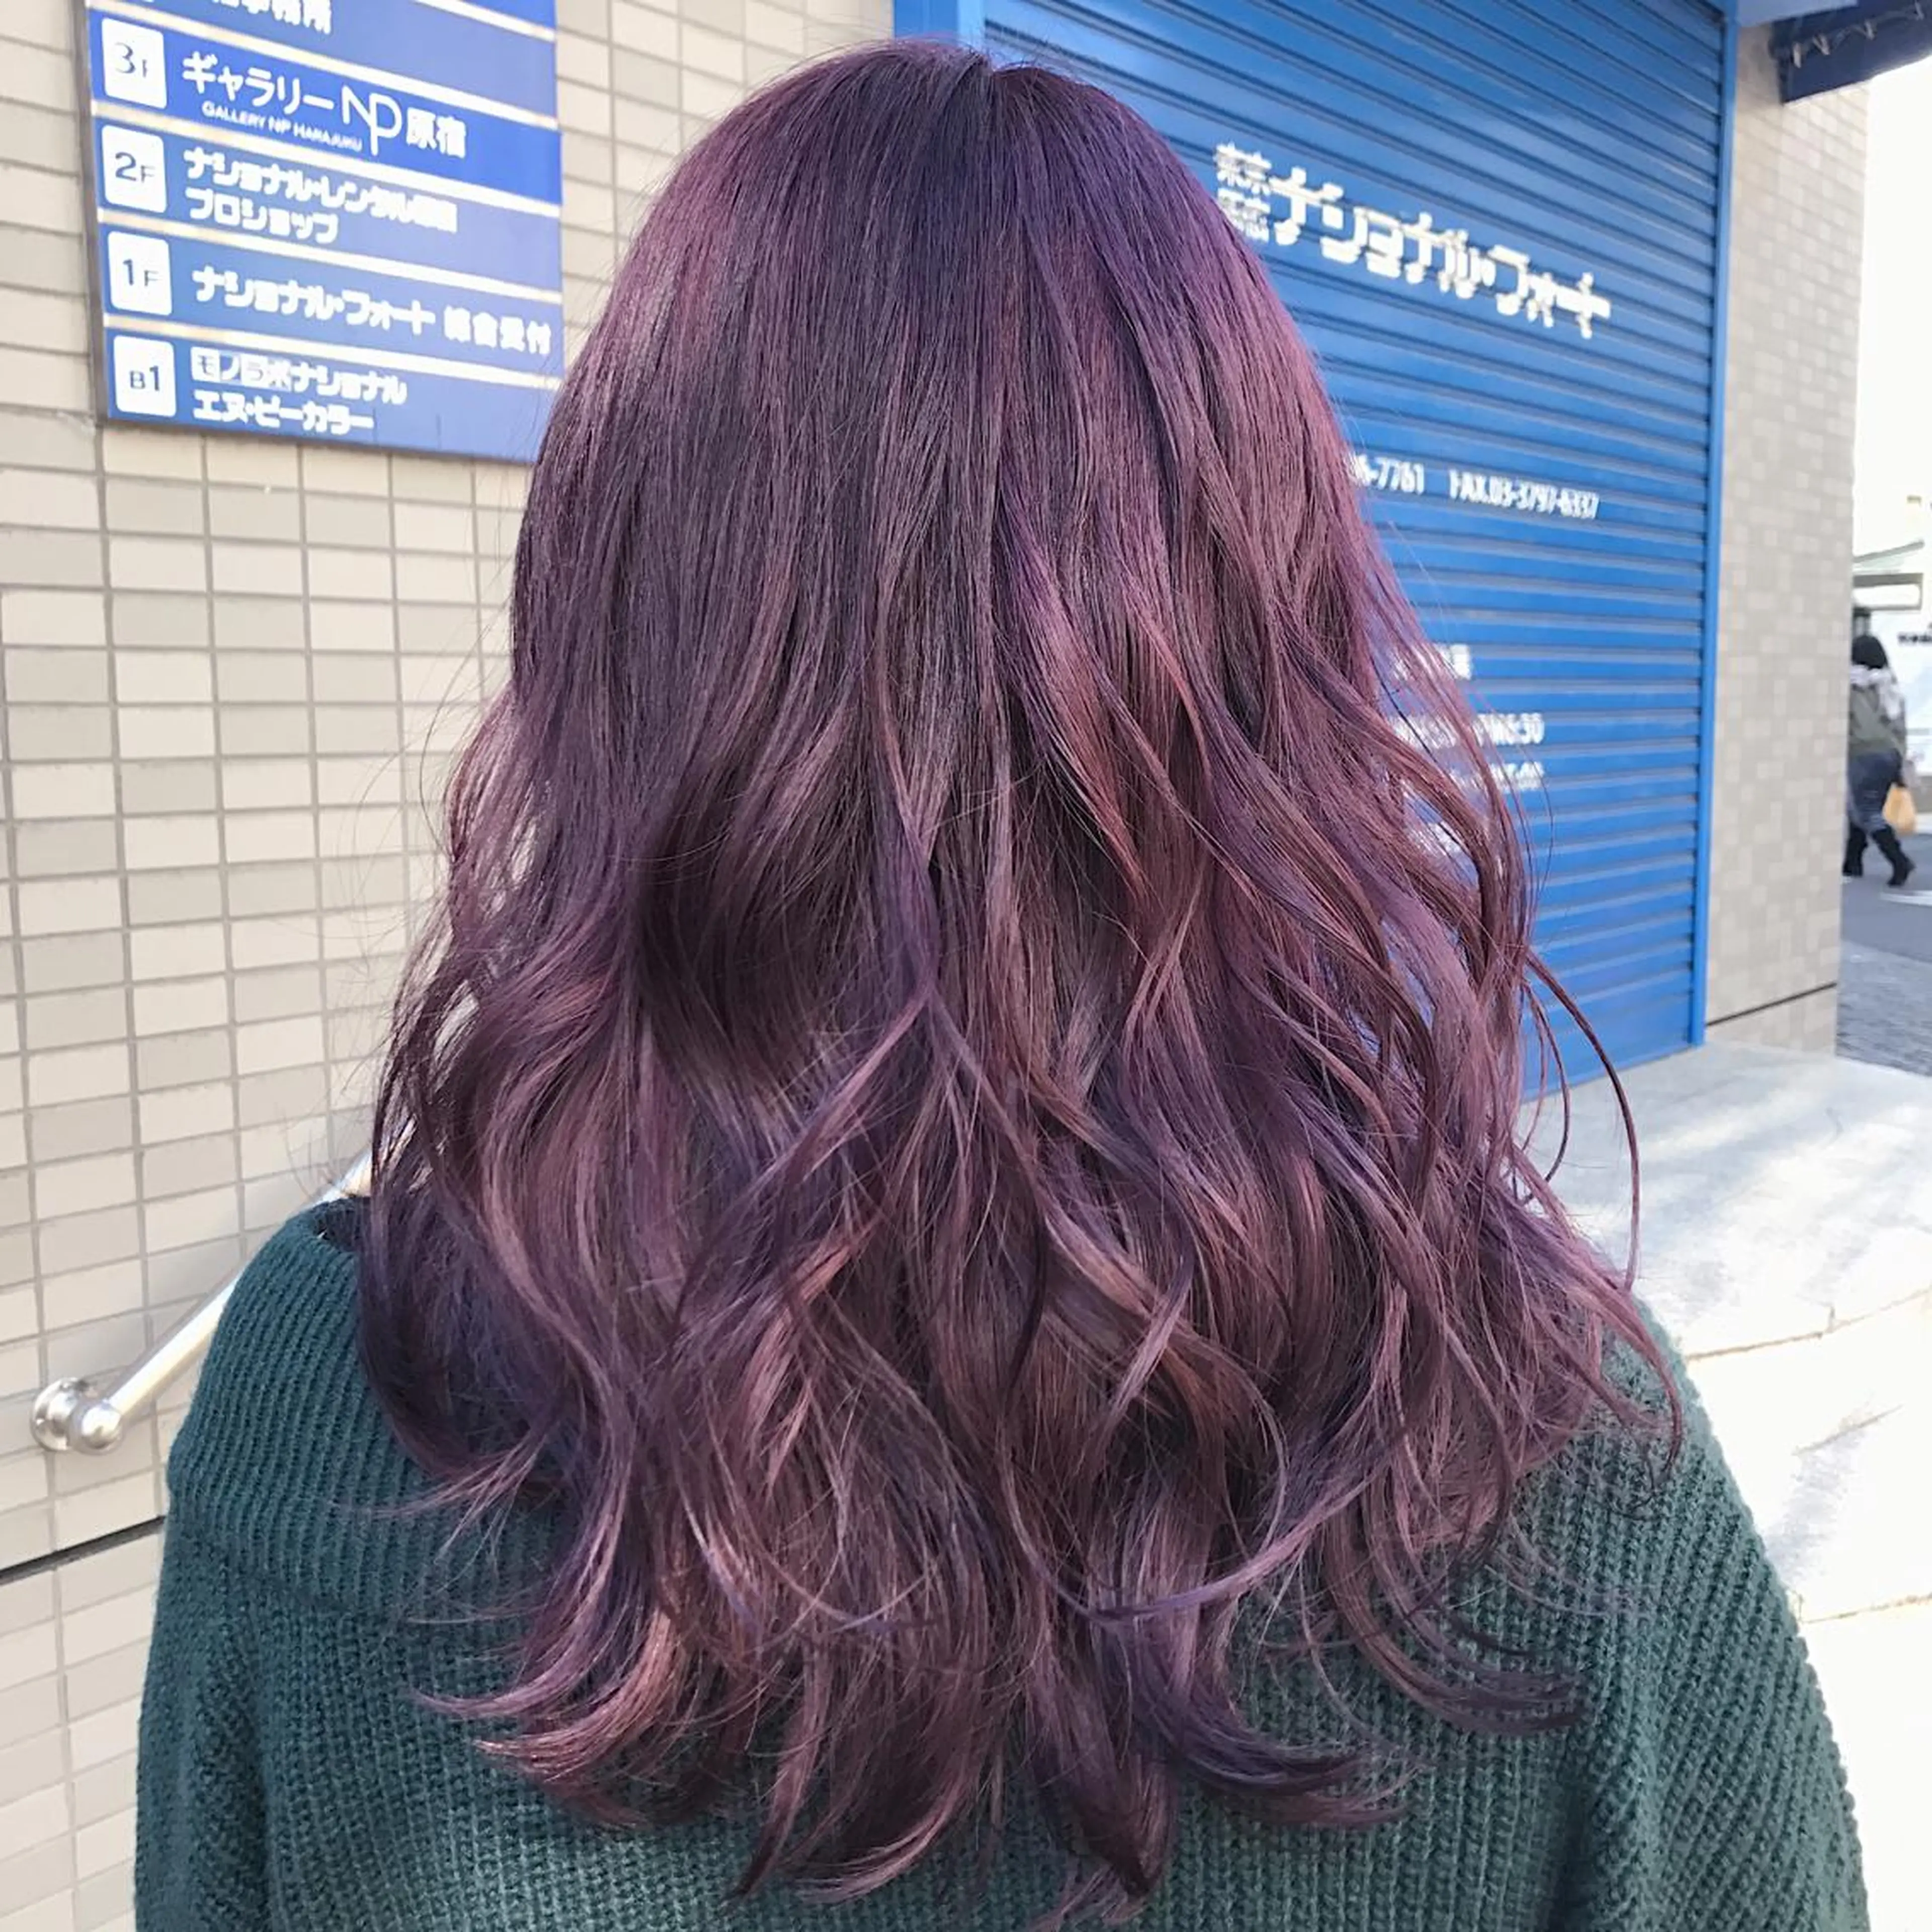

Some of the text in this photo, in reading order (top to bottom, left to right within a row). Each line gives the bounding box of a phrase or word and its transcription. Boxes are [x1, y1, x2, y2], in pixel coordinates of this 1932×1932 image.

[115, 151, 154, 183] 2F
[123, 259, 159, 287] 1F
[130, 365, 159, 391] B1
